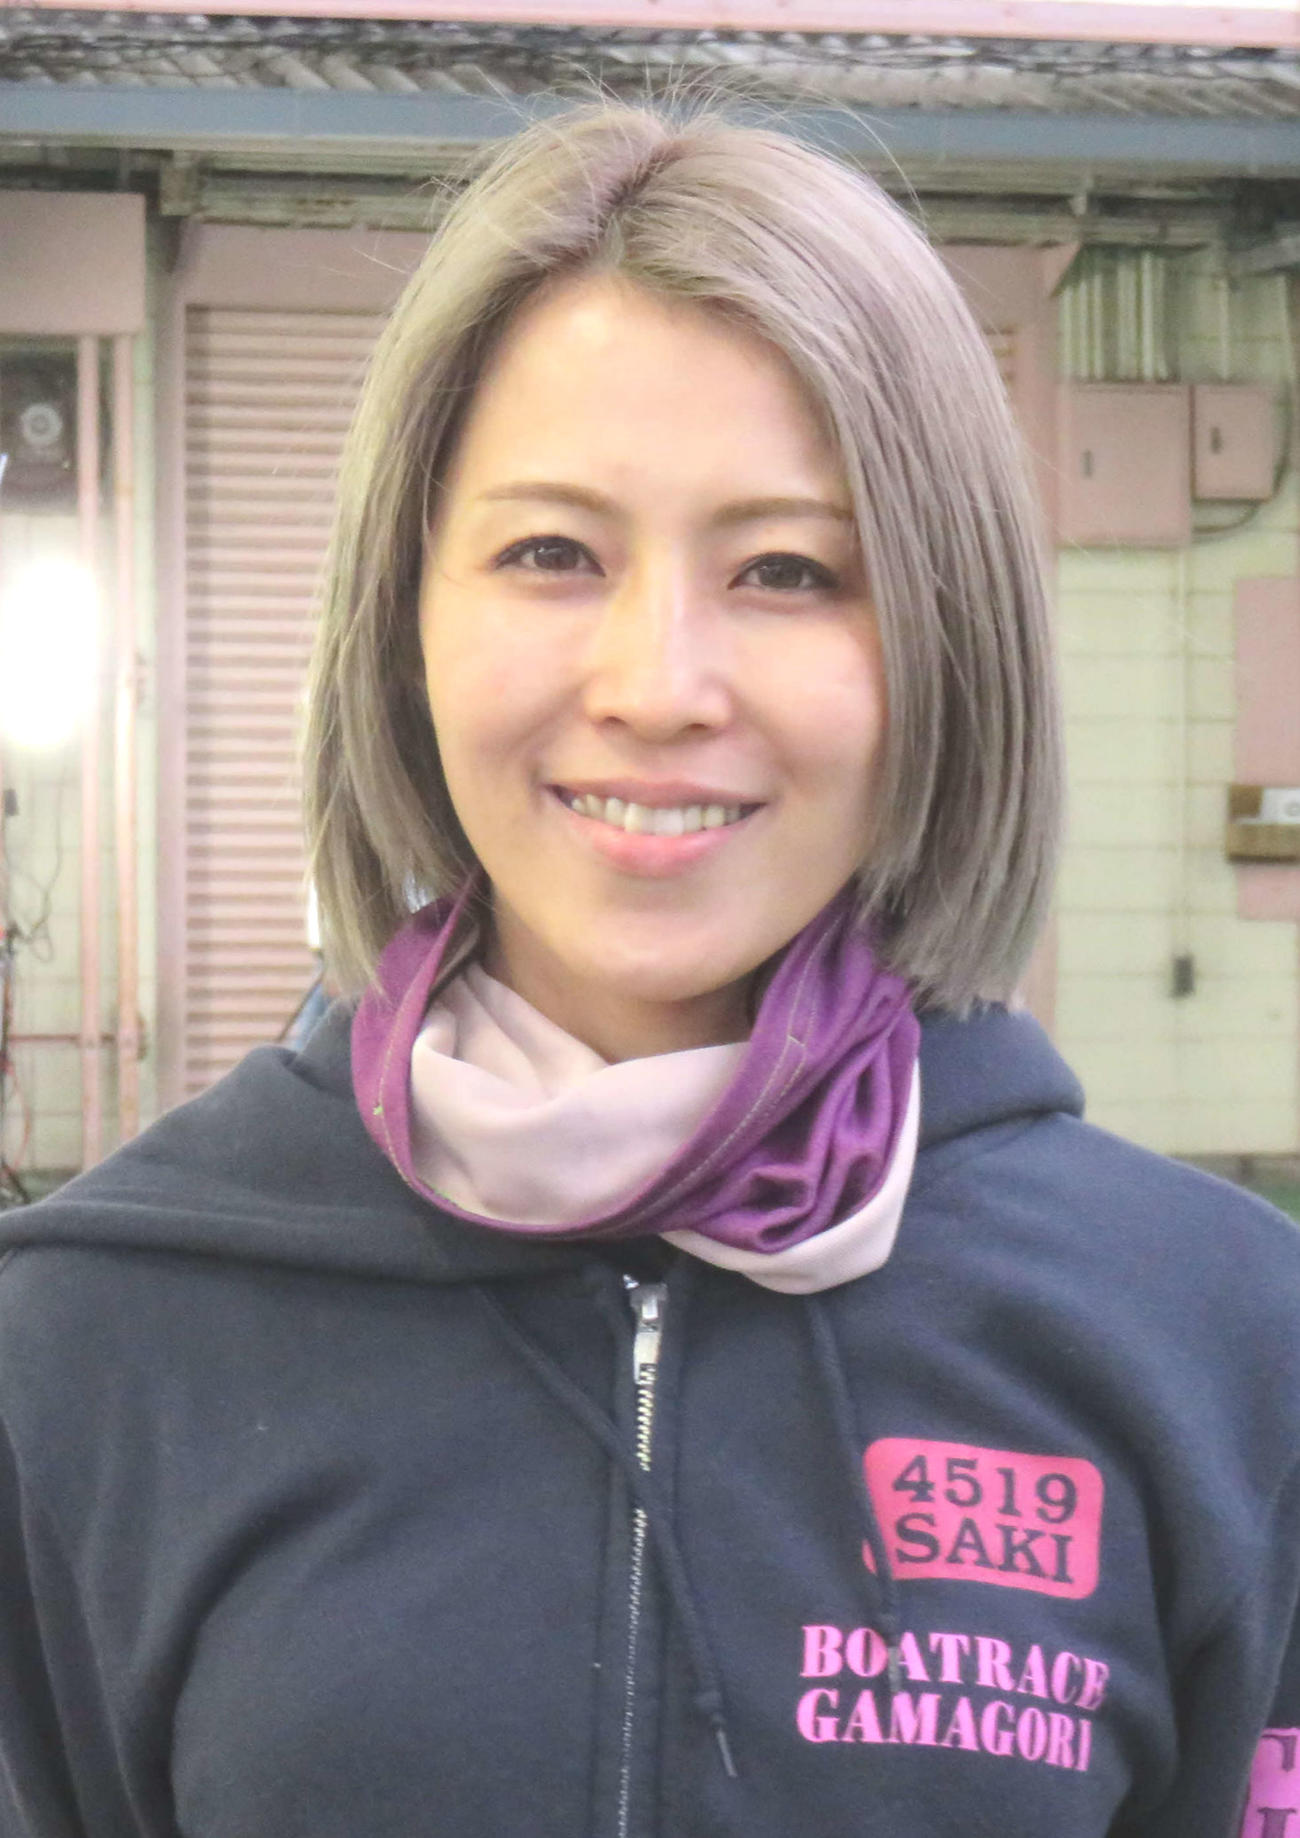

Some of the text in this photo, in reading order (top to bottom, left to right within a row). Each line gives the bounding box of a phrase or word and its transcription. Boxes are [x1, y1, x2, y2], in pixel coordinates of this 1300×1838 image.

[892, 1455, 1077, 1524] 4519
[895, 1513, 1074, 1584] SAKI
[800, 1625, 1109, 1710] BOATRACE
[796, 1688, 1092, 1771] GAMAGORI
